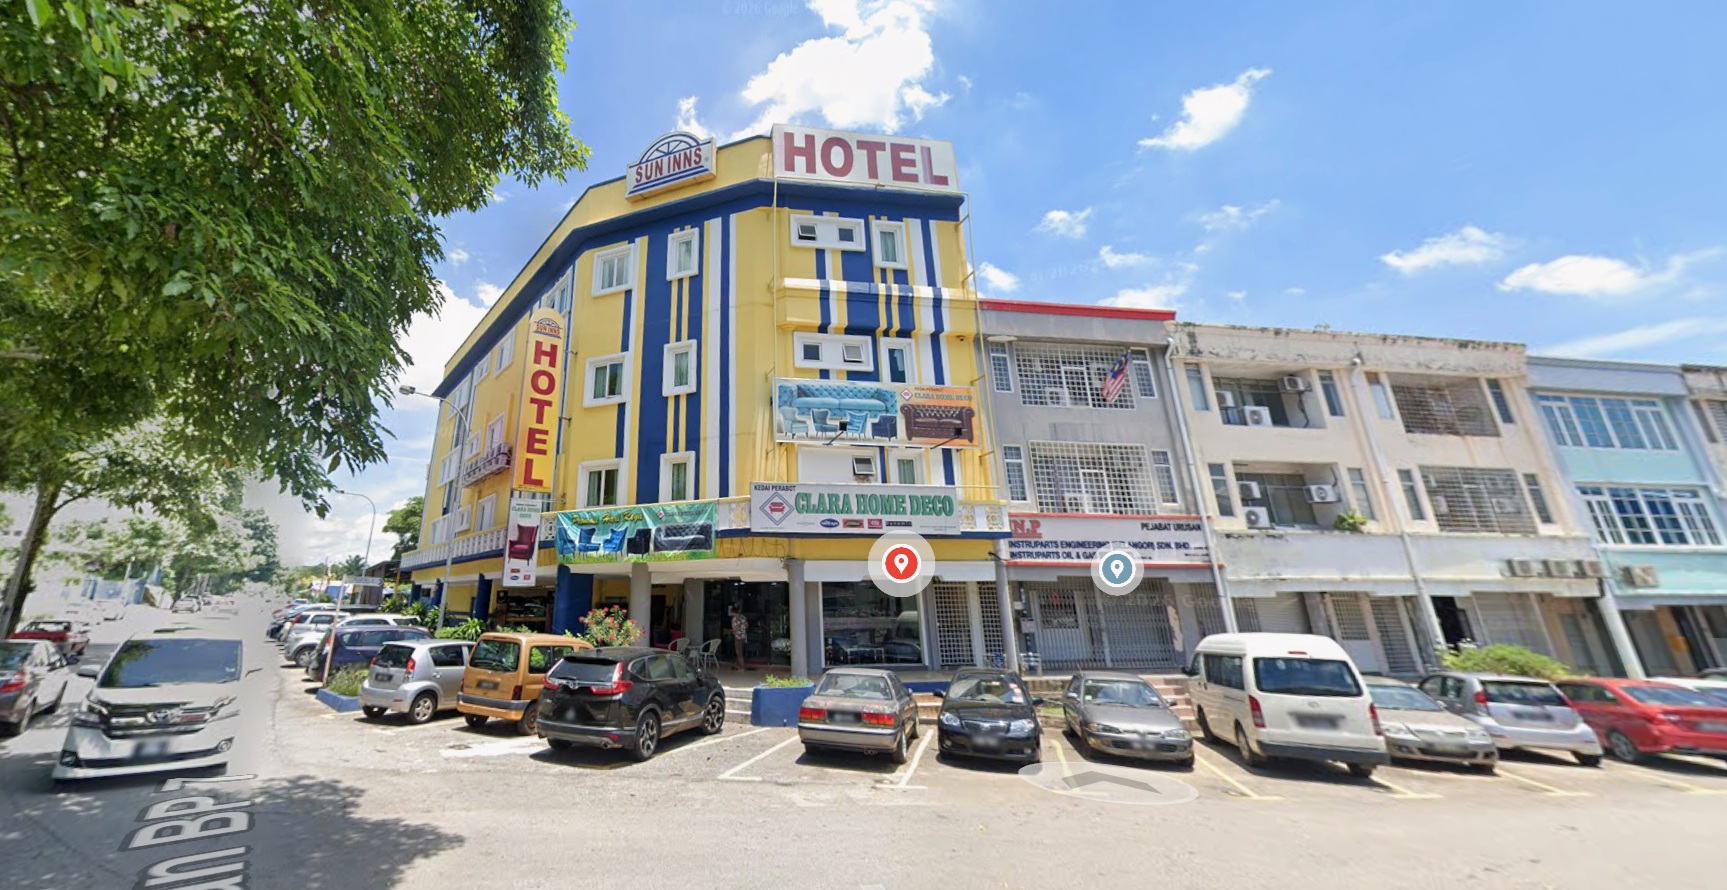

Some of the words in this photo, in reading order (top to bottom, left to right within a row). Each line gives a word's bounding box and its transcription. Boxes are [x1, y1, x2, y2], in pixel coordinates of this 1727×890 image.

[635, 159, 663, 183] SUN
[667, 147, 702, 173] INNS
[783, 131, 949, 186] HOTEL
[523, 340, 558, 487] HOTEL
[794, 492, 853, 515] CLARA
[856, 493, 907, 516] HOME
[909, 494, 954, 517] DECO
[1141, 522, 1171, 531] PEJABAT
[1008, 540, 1058, 549] INSTRUPARTS
[1009, 551, 1060, 559] INSTRUPARTS
[1062, 551, 1074, 559] OIL
[1076, 551, 1081, 559] &
